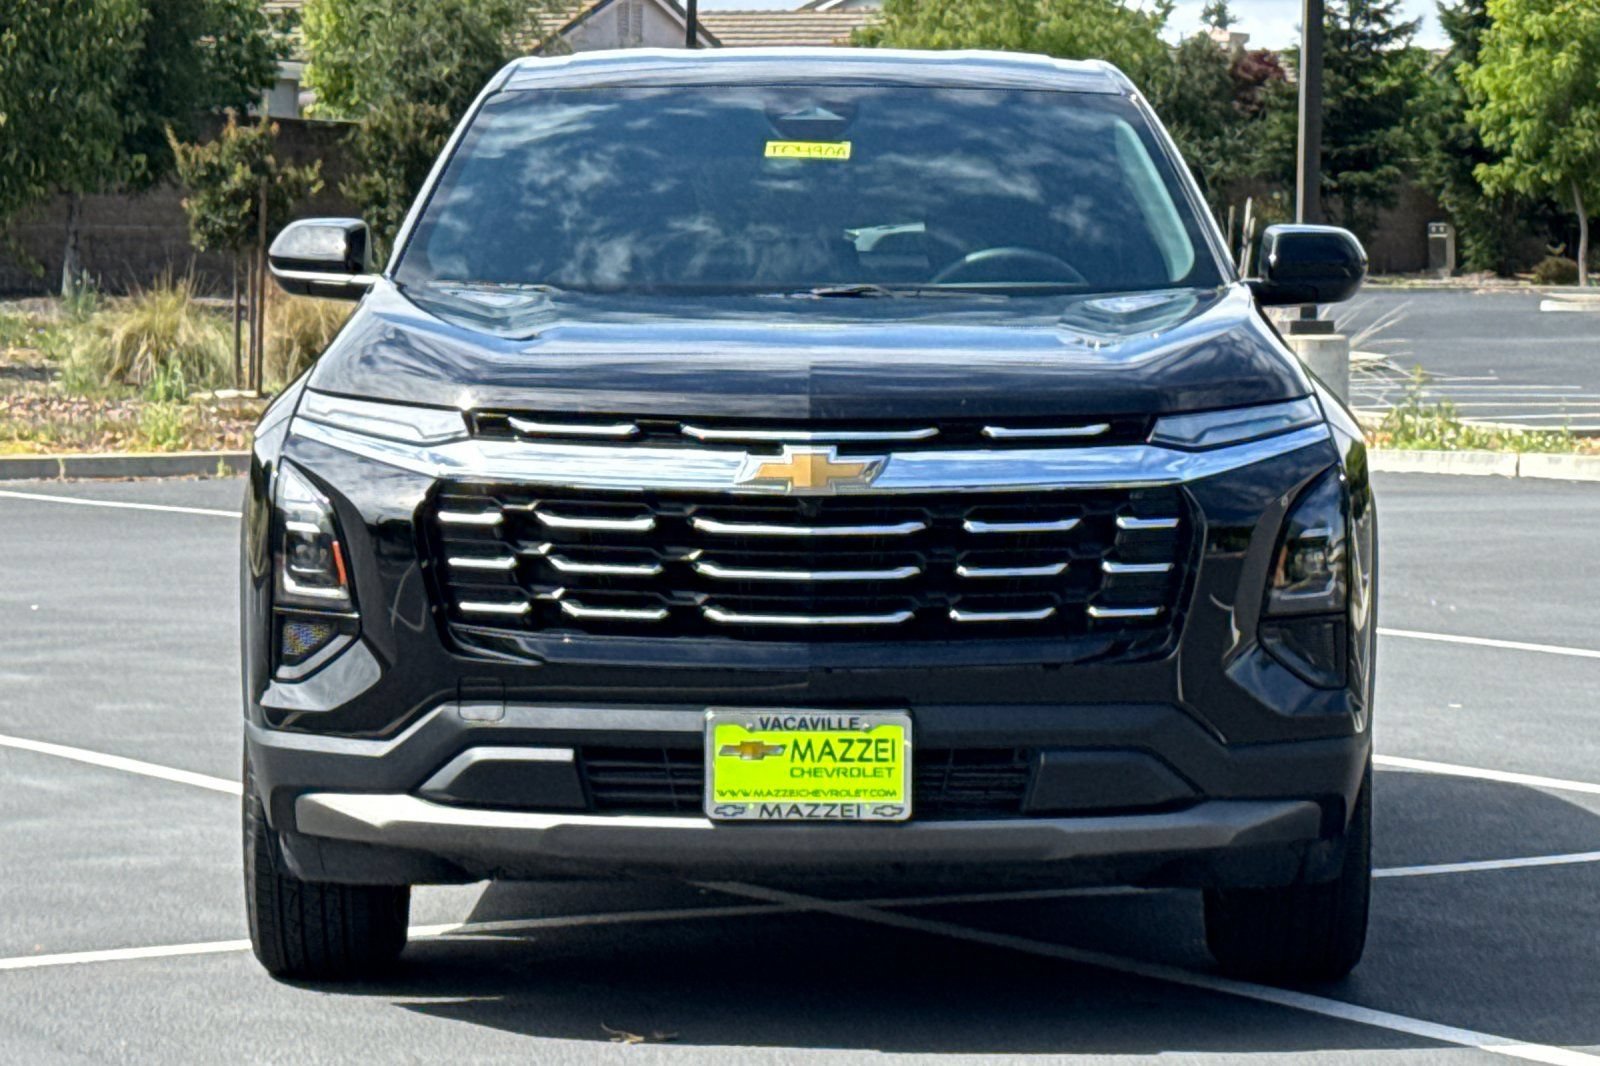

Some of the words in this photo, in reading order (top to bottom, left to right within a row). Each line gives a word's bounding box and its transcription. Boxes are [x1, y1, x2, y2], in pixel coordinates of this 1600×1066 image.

[759, 717, 861, 731] VACAVILLE
[790, 738, 896, 763] MAZZEI
[790, 767, 895, 778] CHEVROLET
[759, 804, 861, 818] MAZZEI
